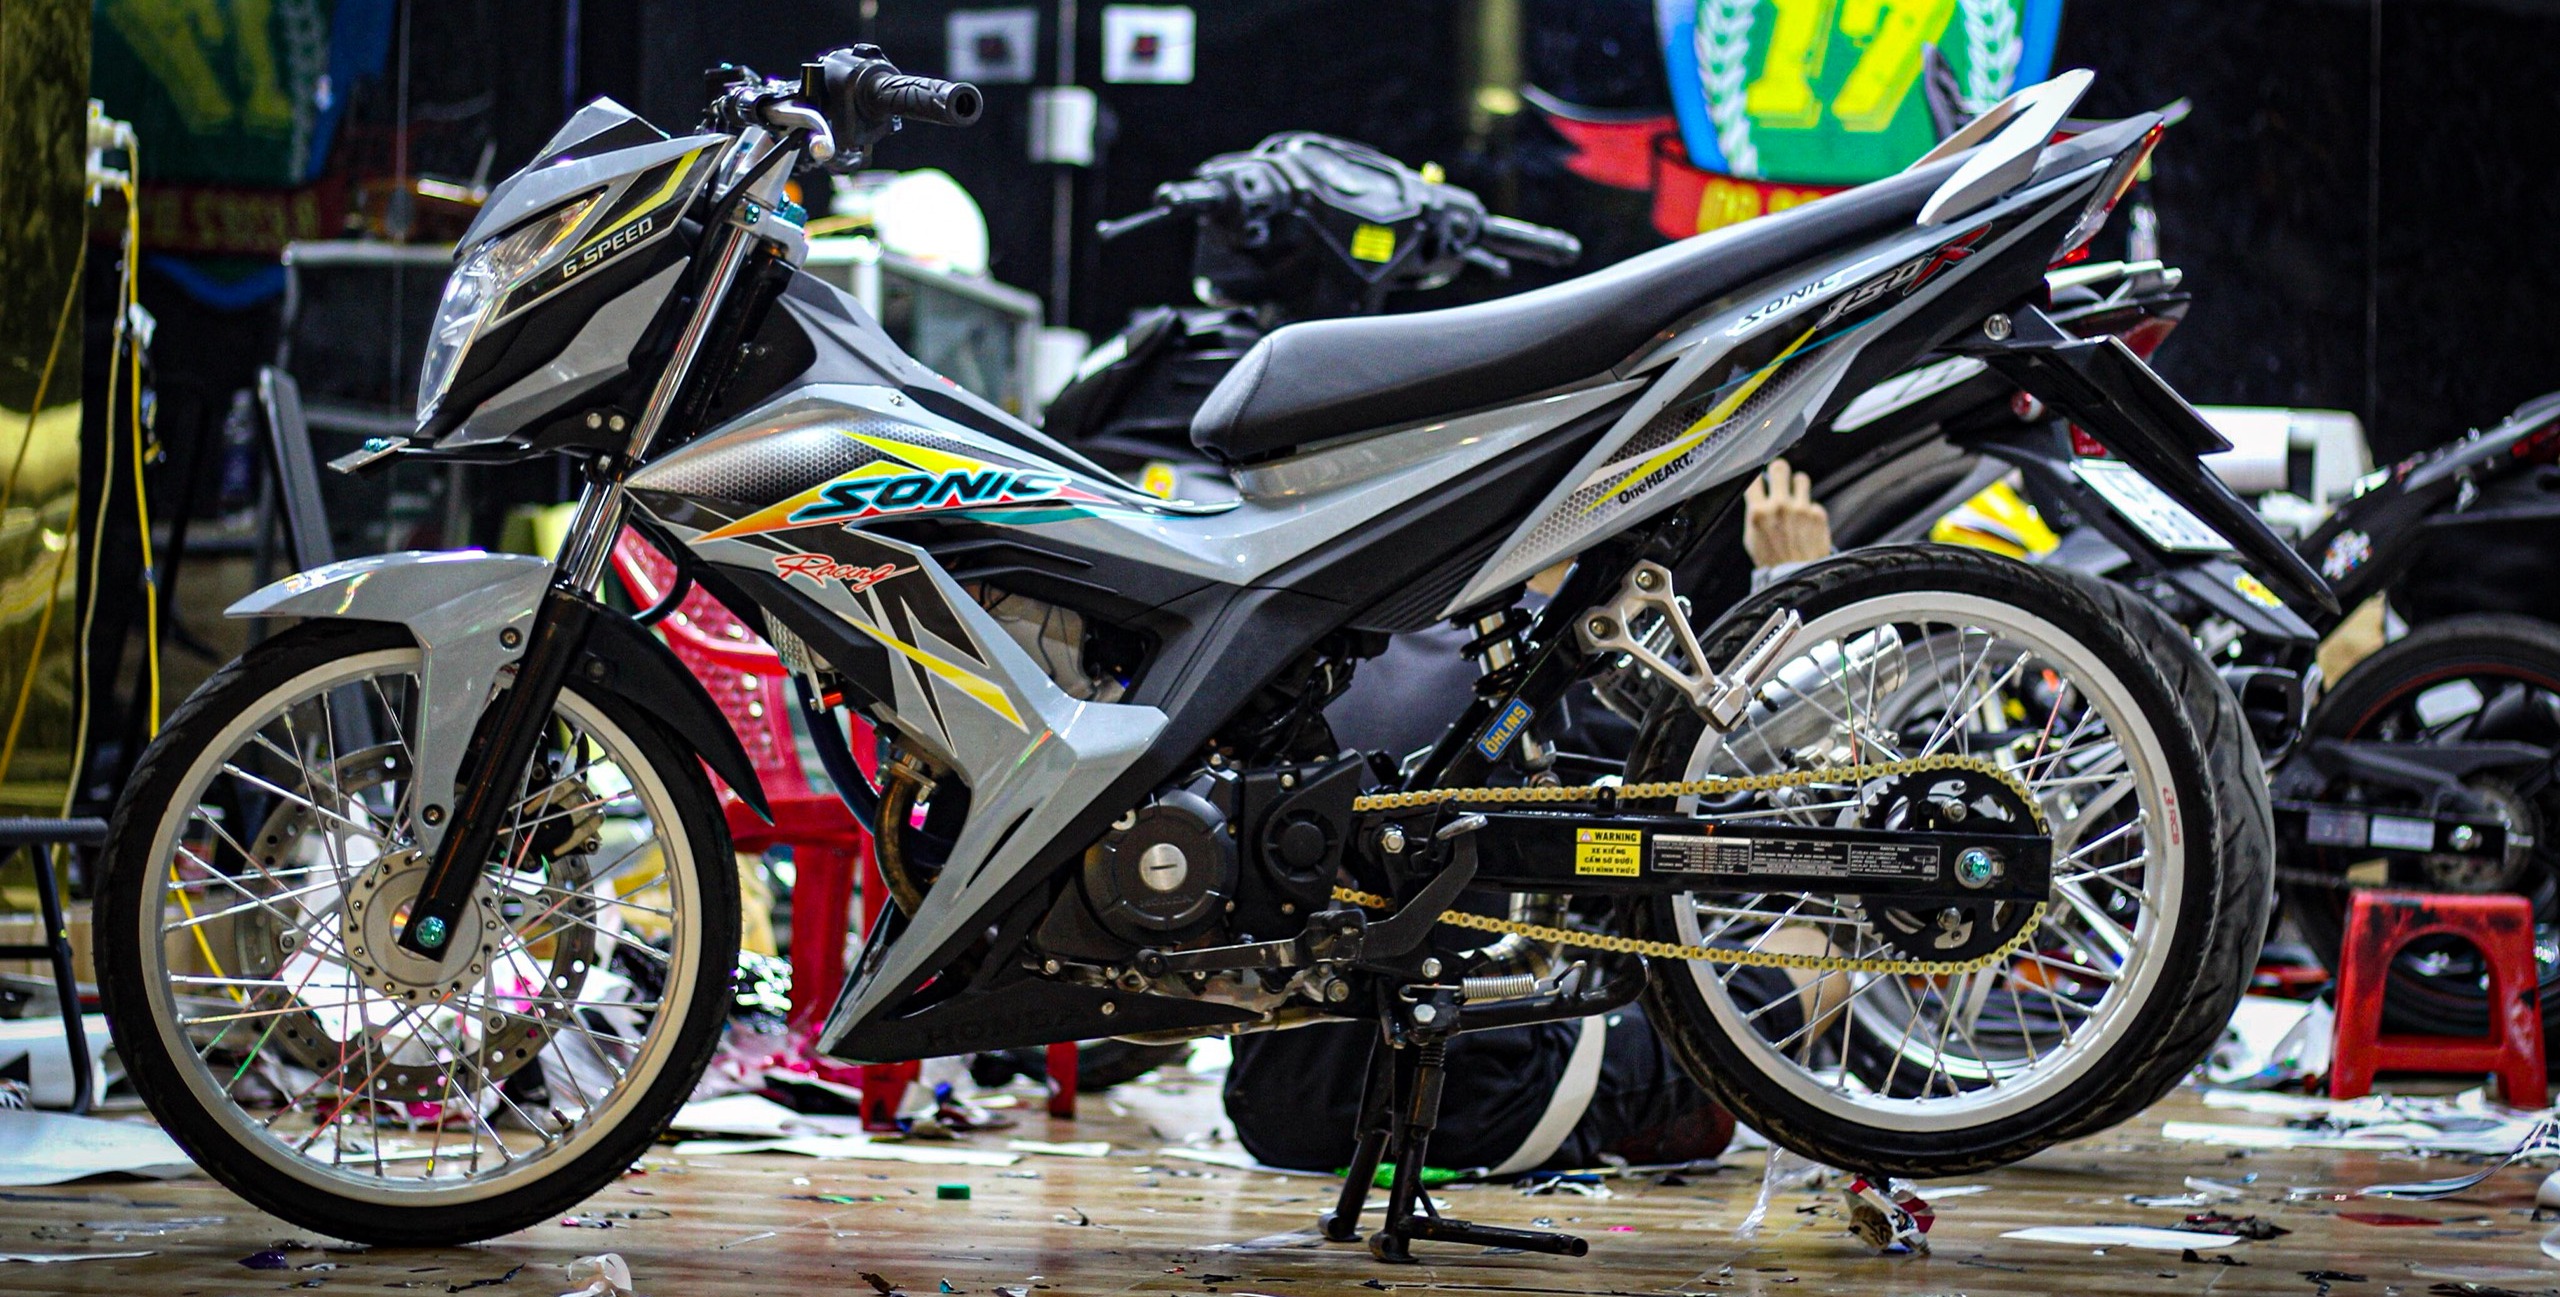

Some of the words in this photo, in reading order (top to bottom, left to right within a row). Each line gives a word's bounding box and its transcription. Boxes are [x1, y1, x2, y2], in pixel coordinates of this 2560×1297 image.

[1746, 0, 1958, 131] 17
[1726, 260, 1862, 337] SONIC
[789, 469, 1073, 522] SONIC
[774, 552, 920, 593] Racing
[1595, 831, 1637, 842] WARNING
